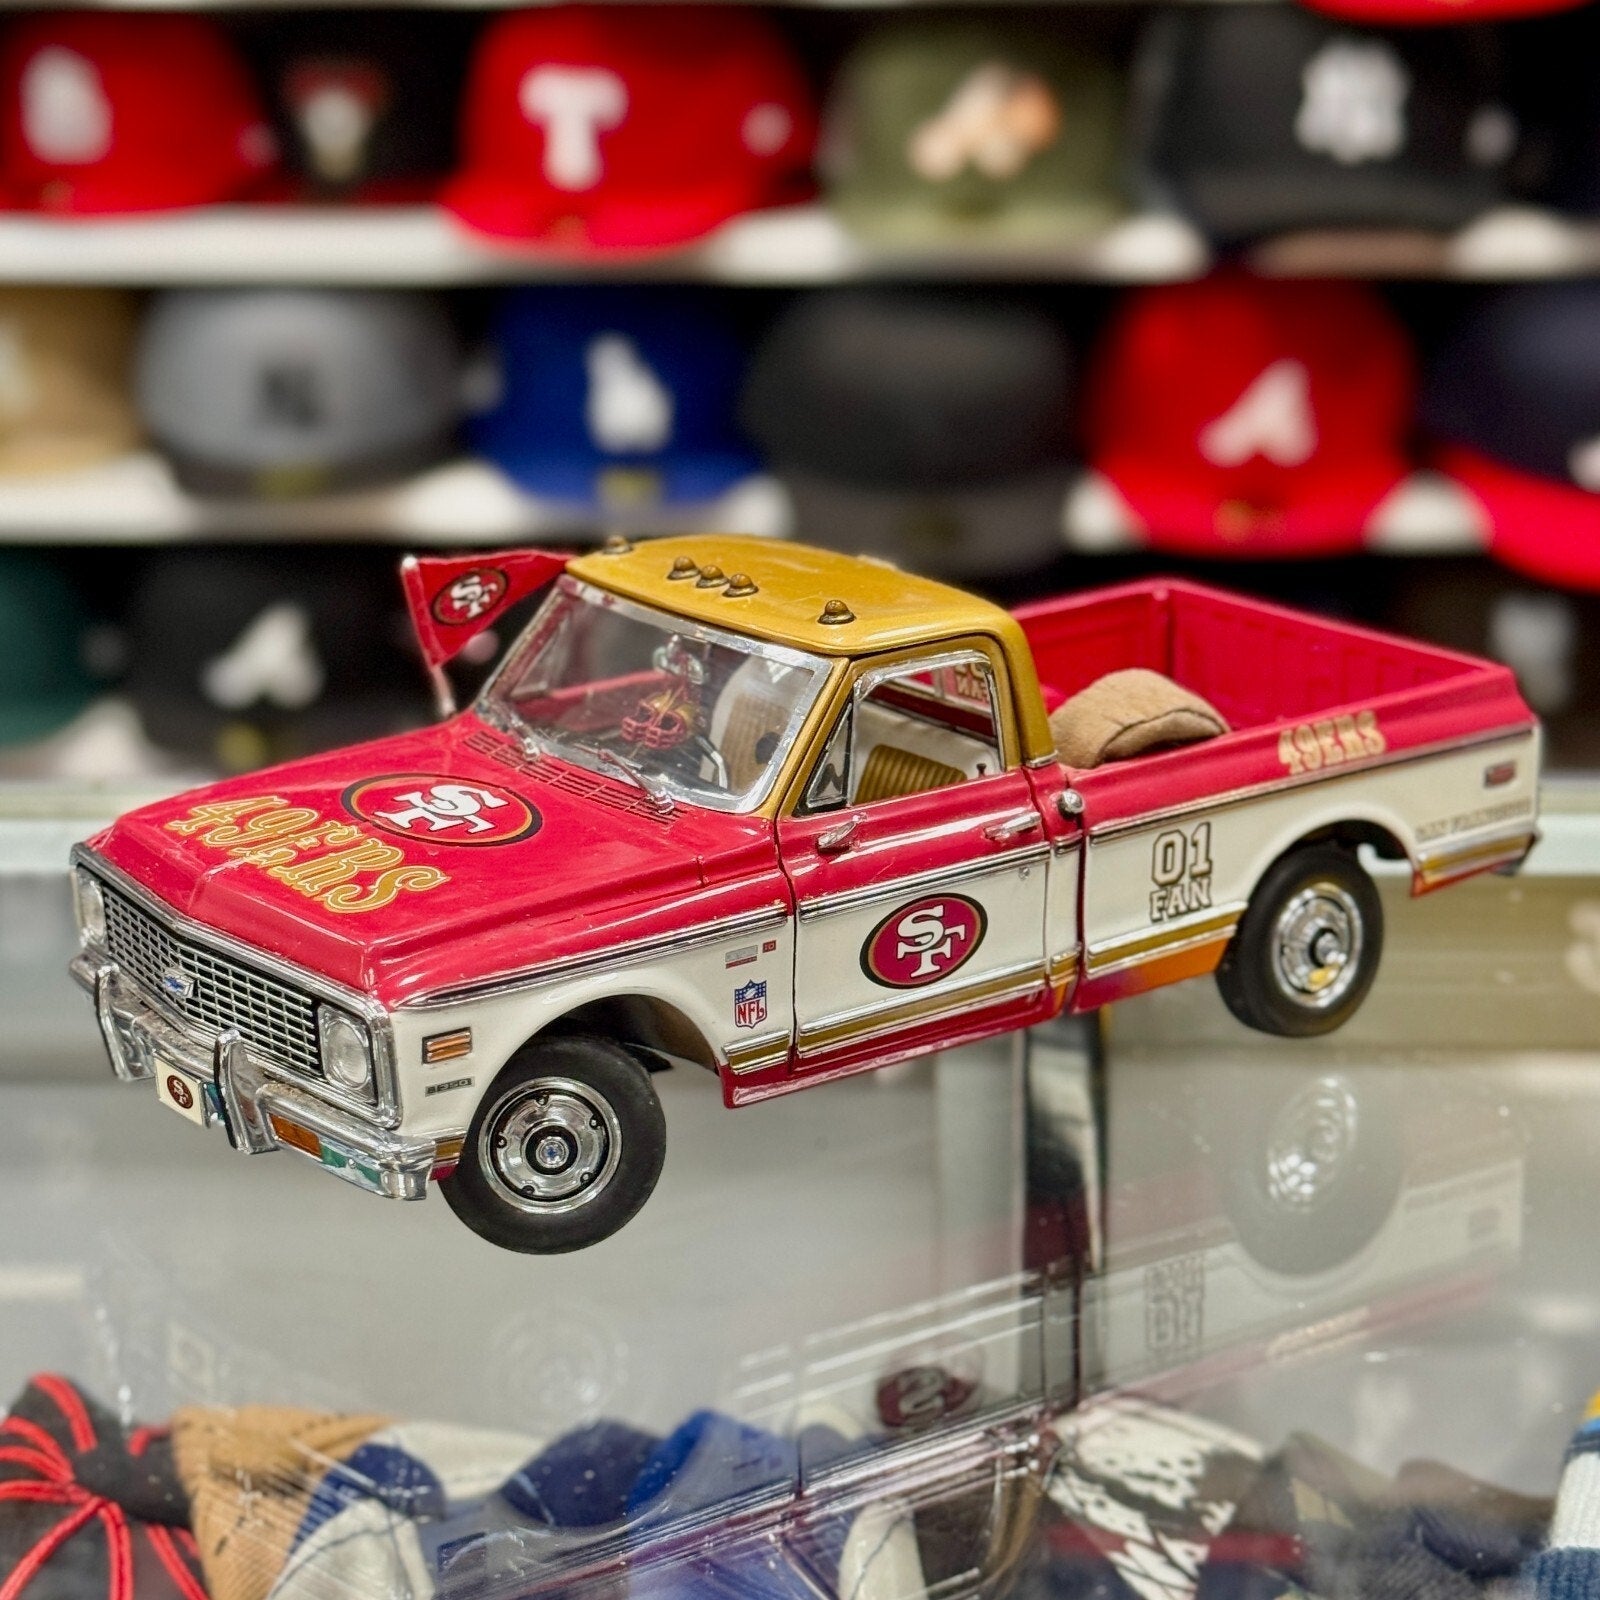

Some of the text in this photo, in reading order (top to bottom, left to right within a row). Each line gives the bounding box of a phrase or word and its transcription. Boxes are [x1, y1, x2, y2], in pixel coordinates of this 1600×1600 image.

[1277, 709, 1386, 775] 49ERS
[165, 795, 451, 913] 49ERS
[1151, 821, 1213, 888] 01
[1149, 876, 1213, 923] FAN
[897, 904, 966, 978] SF
[737, 999, 765, 1025] NFL
